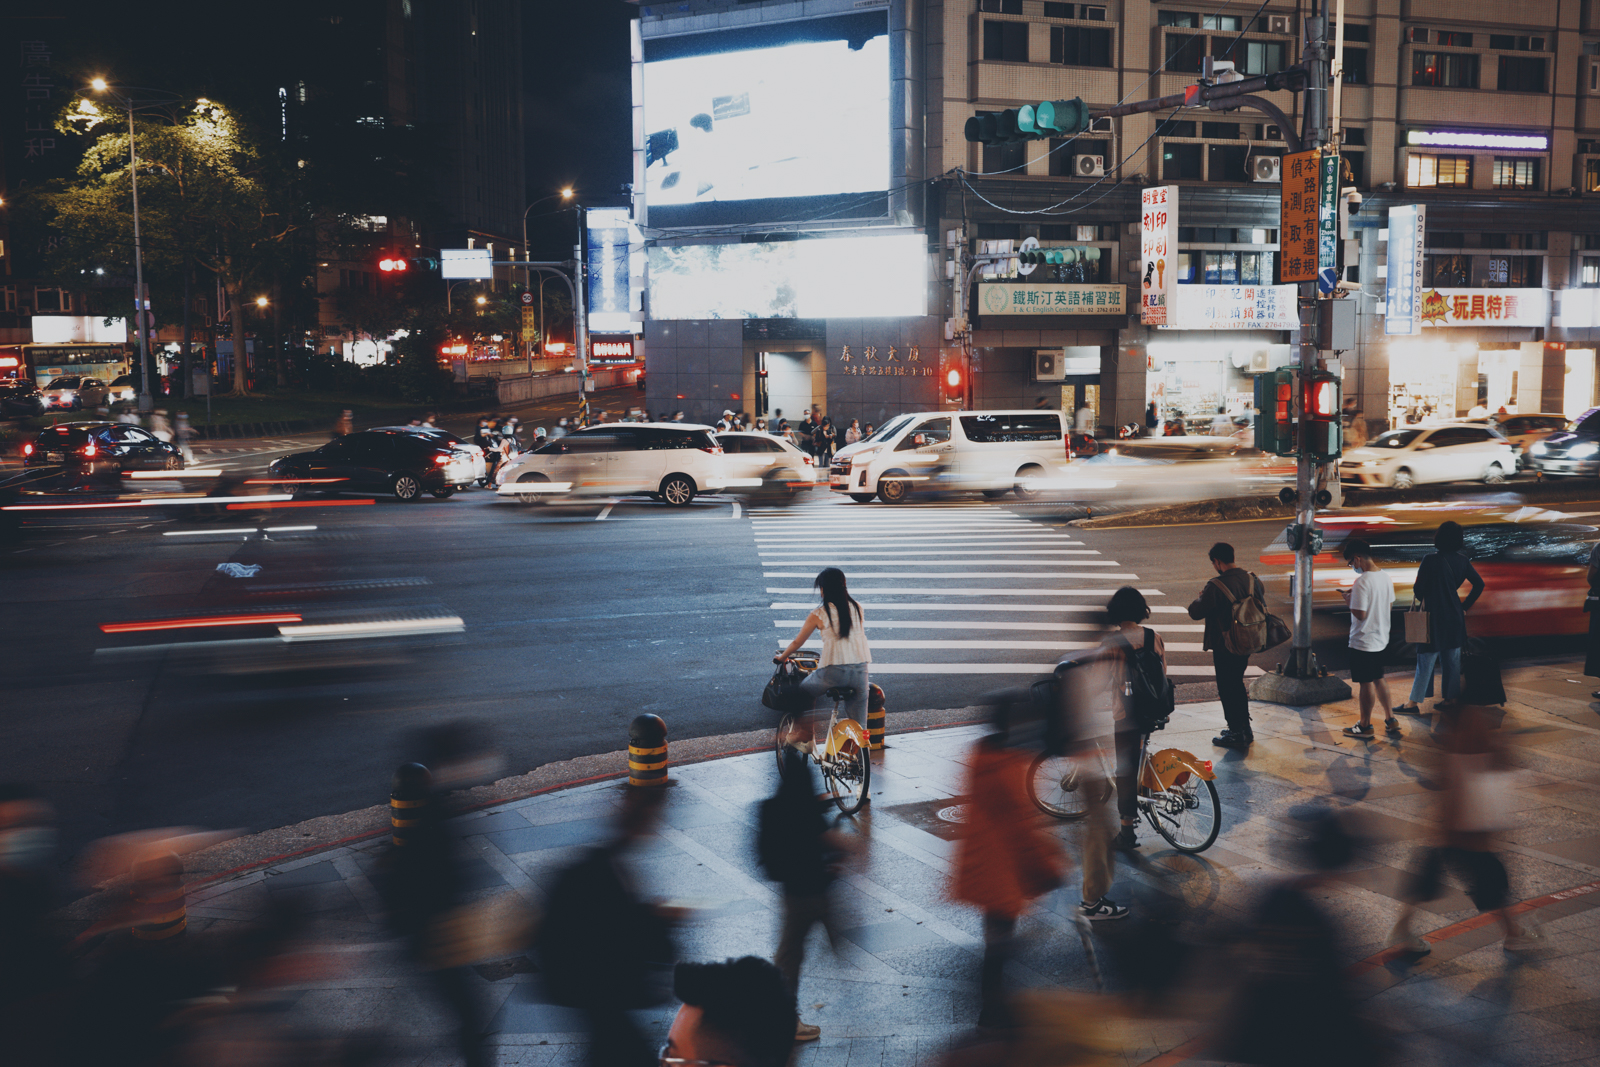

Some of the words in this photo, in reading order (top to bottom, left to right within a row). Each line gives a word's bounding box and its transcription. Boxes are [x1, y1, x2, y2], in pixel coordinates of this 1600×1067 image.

[1288, 158, 1303, 277] 偵測取締
[1303, 155, 1317, 276] 本路段有違規
[1012, 290, 1121, 306] 鐵斯汀英語補習班
[1032, 306, 1054, 315] English
